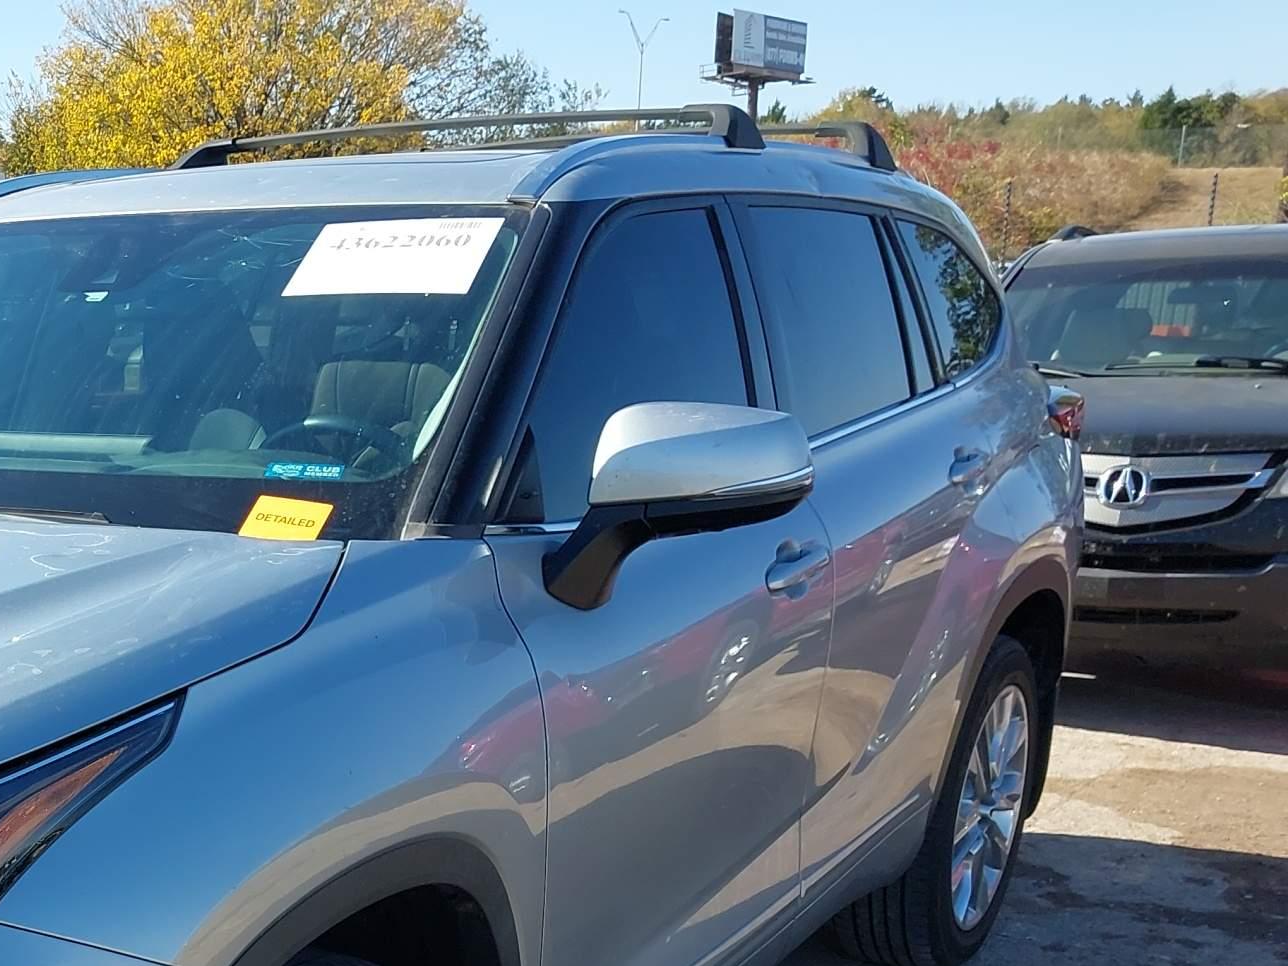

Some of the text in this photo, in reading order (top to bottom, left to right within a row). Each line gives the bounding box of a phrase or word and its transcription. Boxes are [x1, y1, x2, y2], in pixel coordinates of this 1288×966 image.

[329, 233, 472, 251] 43622060
[306, 464, 341, 473] CLUB
[255, 512, 316, 528] DETAILED
